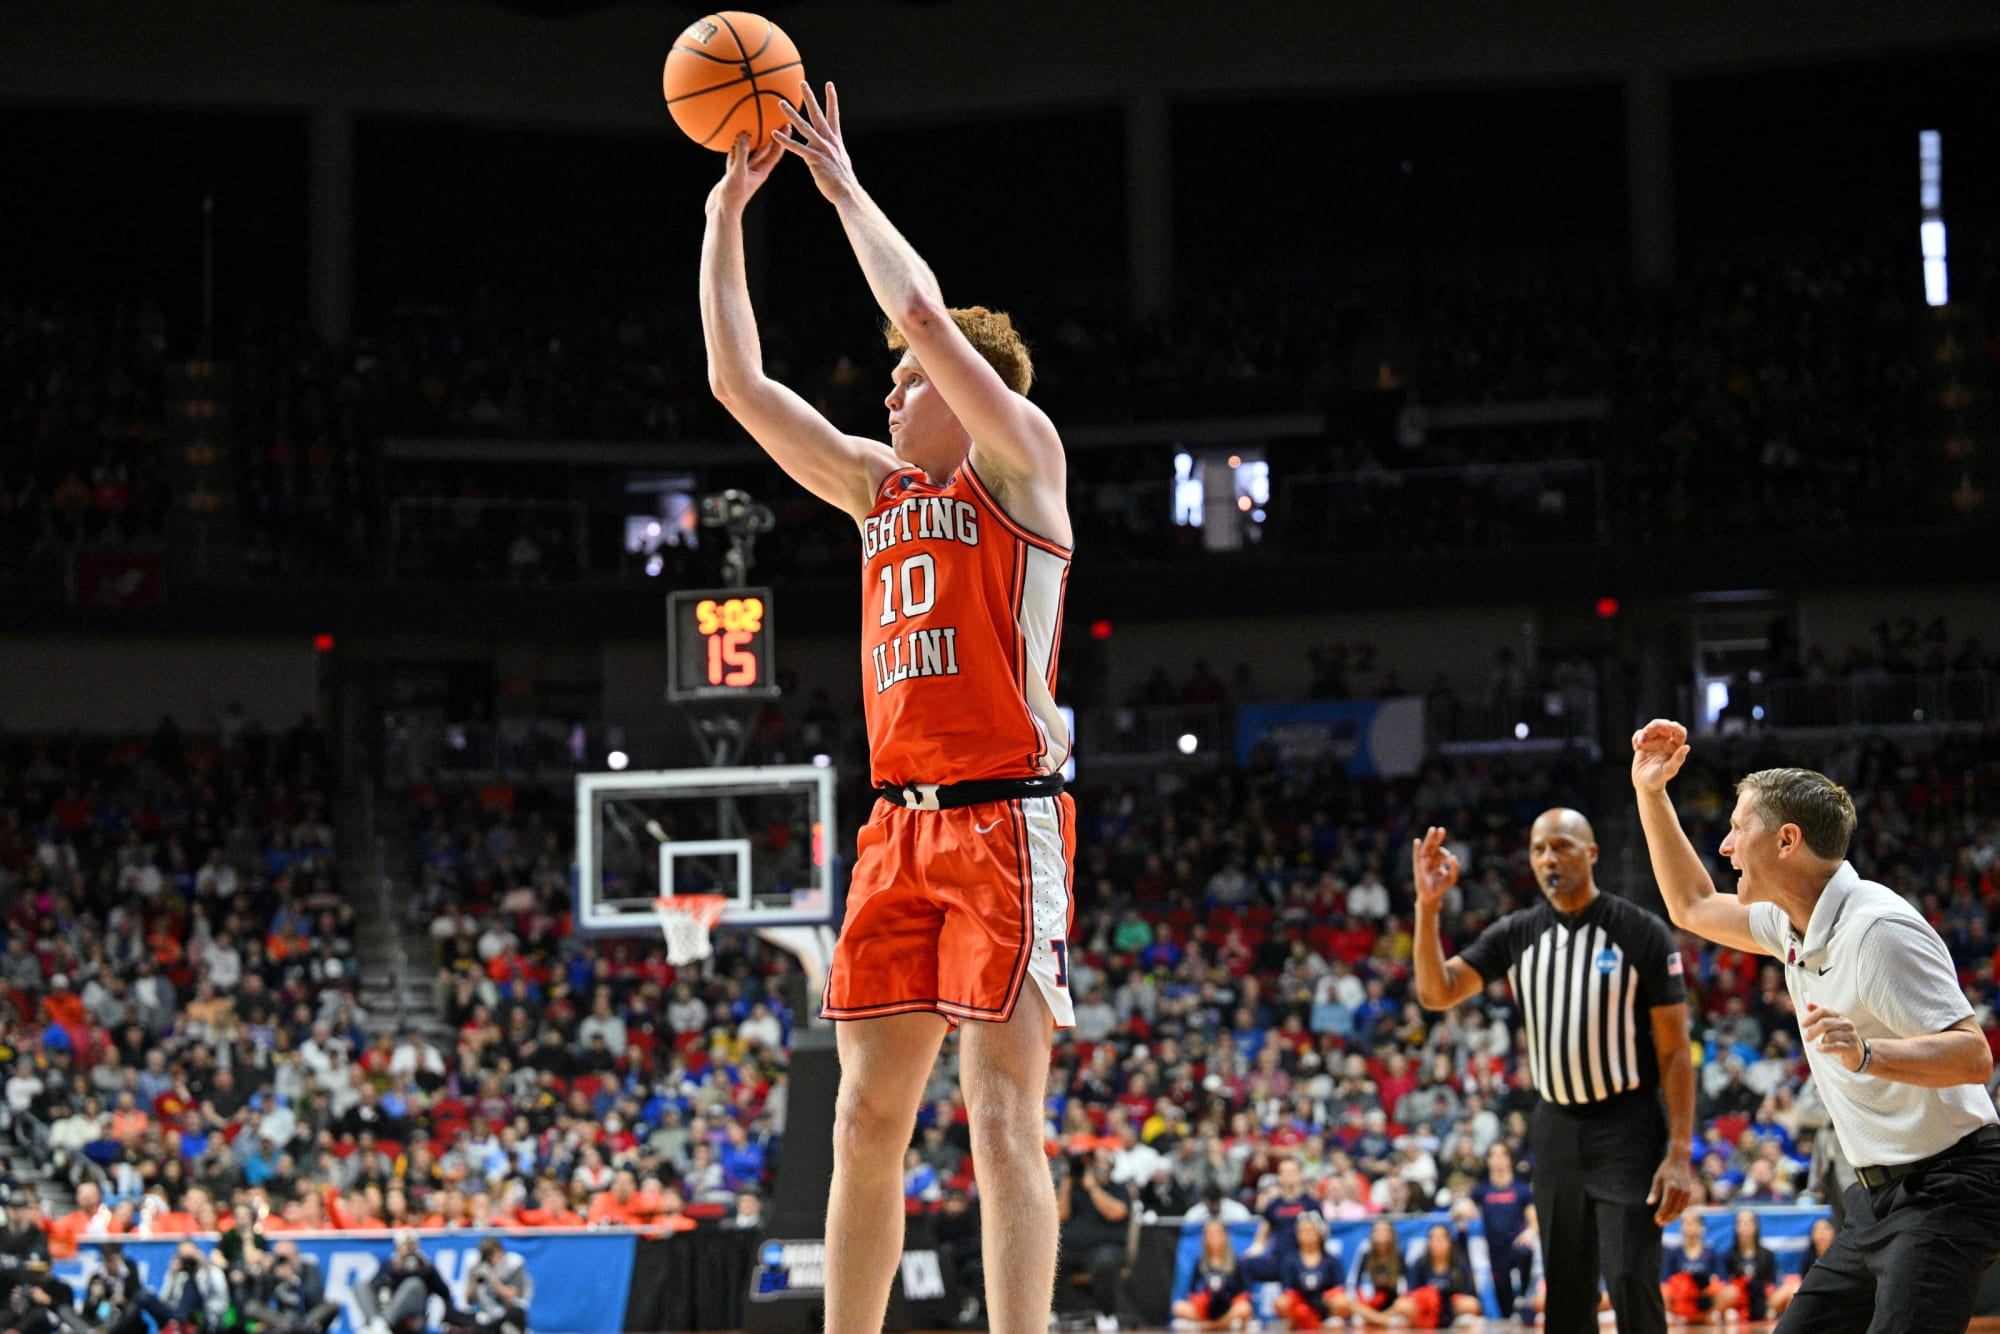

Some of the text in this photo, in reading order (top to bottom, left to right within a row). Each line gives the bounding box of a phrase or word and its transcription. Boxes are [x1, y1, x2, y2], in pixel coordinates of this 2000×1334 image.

[862, 496, 979, 567] GHTING
[695, 597, 763, 635] 5:02
[879, 553, 936, 627] 10
[707, 631, 757, 687] 15
[872, 627, 959, 694] ILLINI
